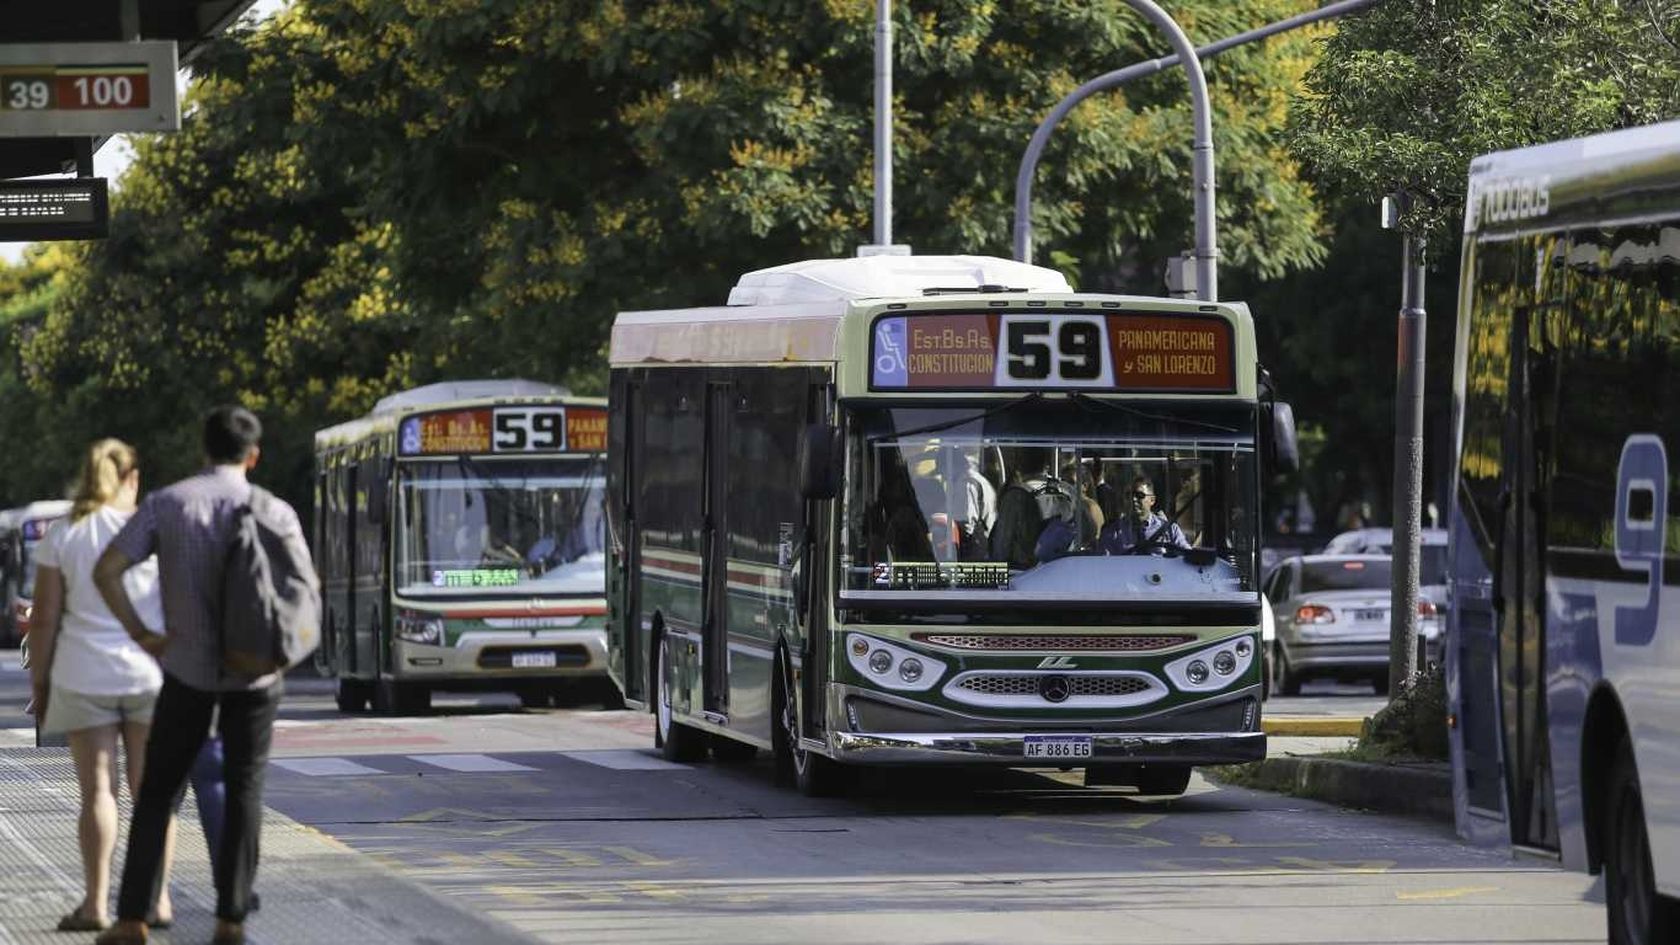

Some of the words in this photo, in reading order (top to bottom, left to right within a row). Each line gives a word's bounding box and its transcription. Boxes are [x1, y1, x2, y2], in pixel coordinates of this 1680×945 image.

[9, 82, 49, 109] 39
[74, 77, 133, 105] 100
[1007, 321, 1102, 381] 59
[1118, 330, 1215, 350] PANAMERICANA
[908, 353, 993, 374] CONSTITUCION
[1137, 354, 1161, 374] SAN
[1164, 354, 1216, 375] LORENZO
[496, 412, 563, 449] 59
[1614, 433, 1668, 646] 9
[1027, 744, 1042, 756] AF
[1047, 744, 1069, 756] 886
[1074, 744, 1089, 756] EG
